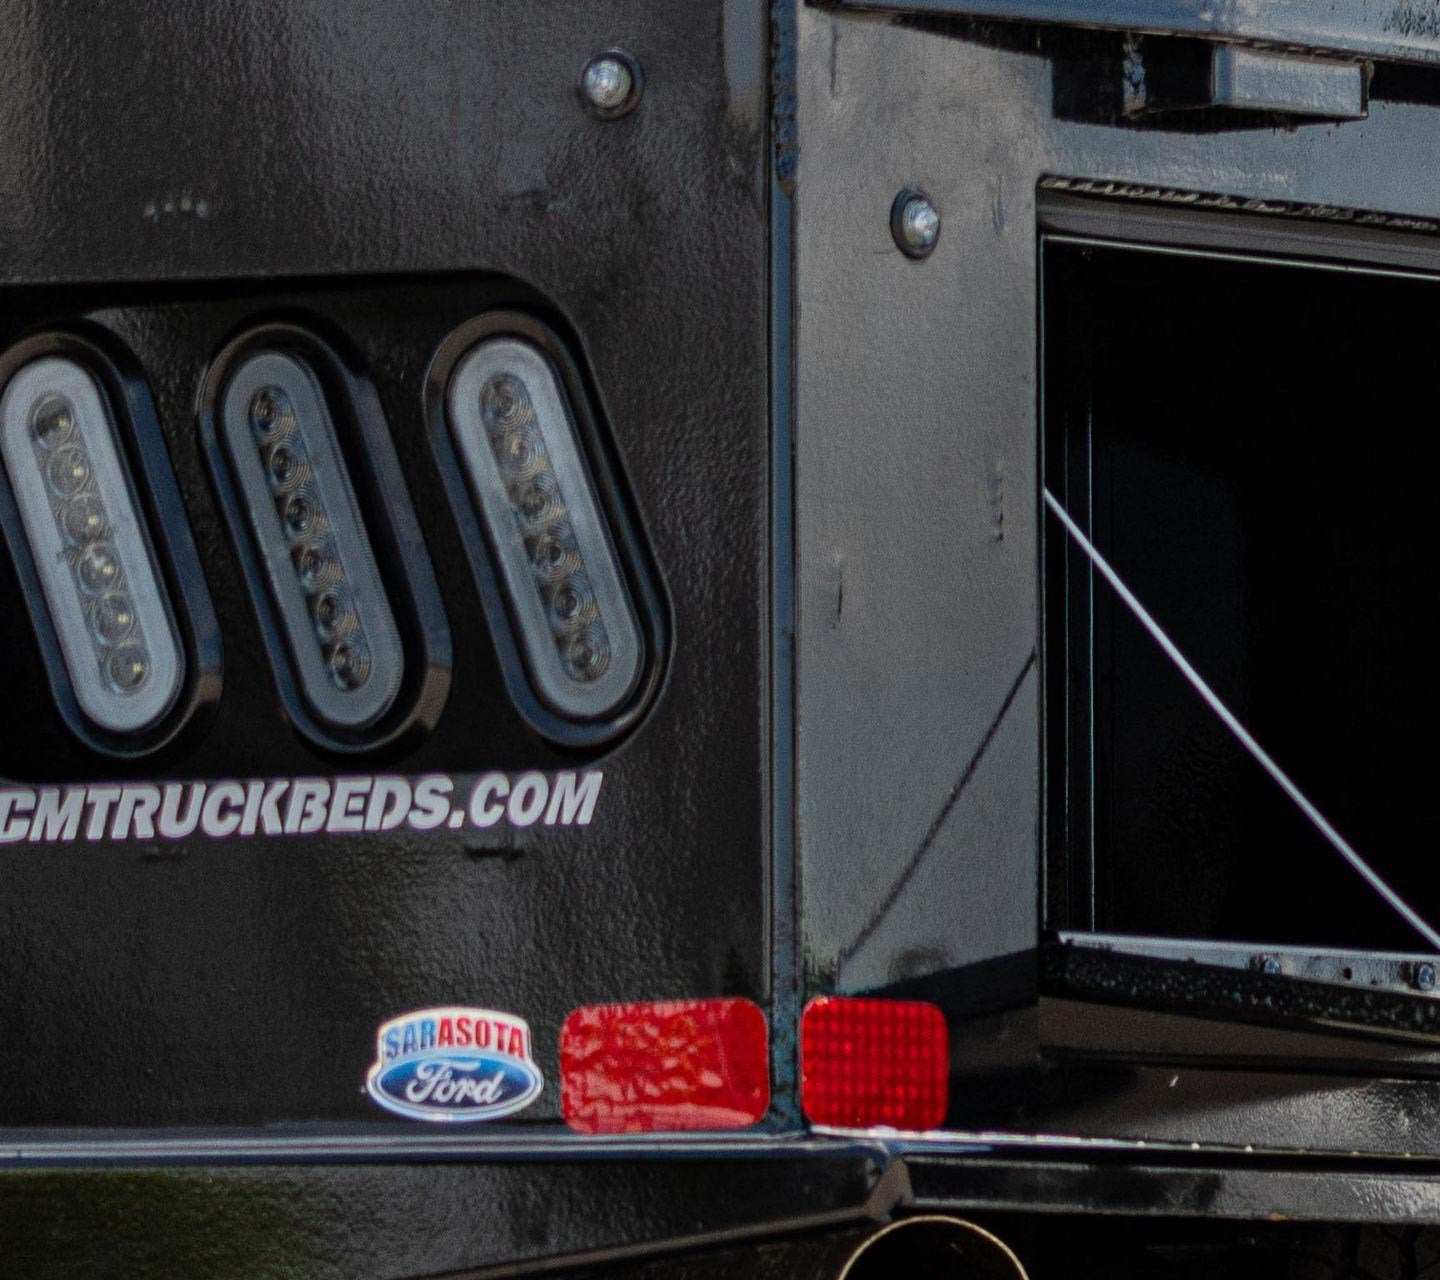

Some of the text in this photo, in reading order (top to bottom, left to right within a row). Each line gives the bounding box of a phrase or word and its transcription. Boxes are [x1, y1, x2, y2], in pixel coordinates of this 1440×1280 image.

[0, 771, 604, 844] CMTRUCKBEDS.COM
[385, 1017, 525, 1061] SARASOTA
[406, 1058, 505, 1104] Ford
